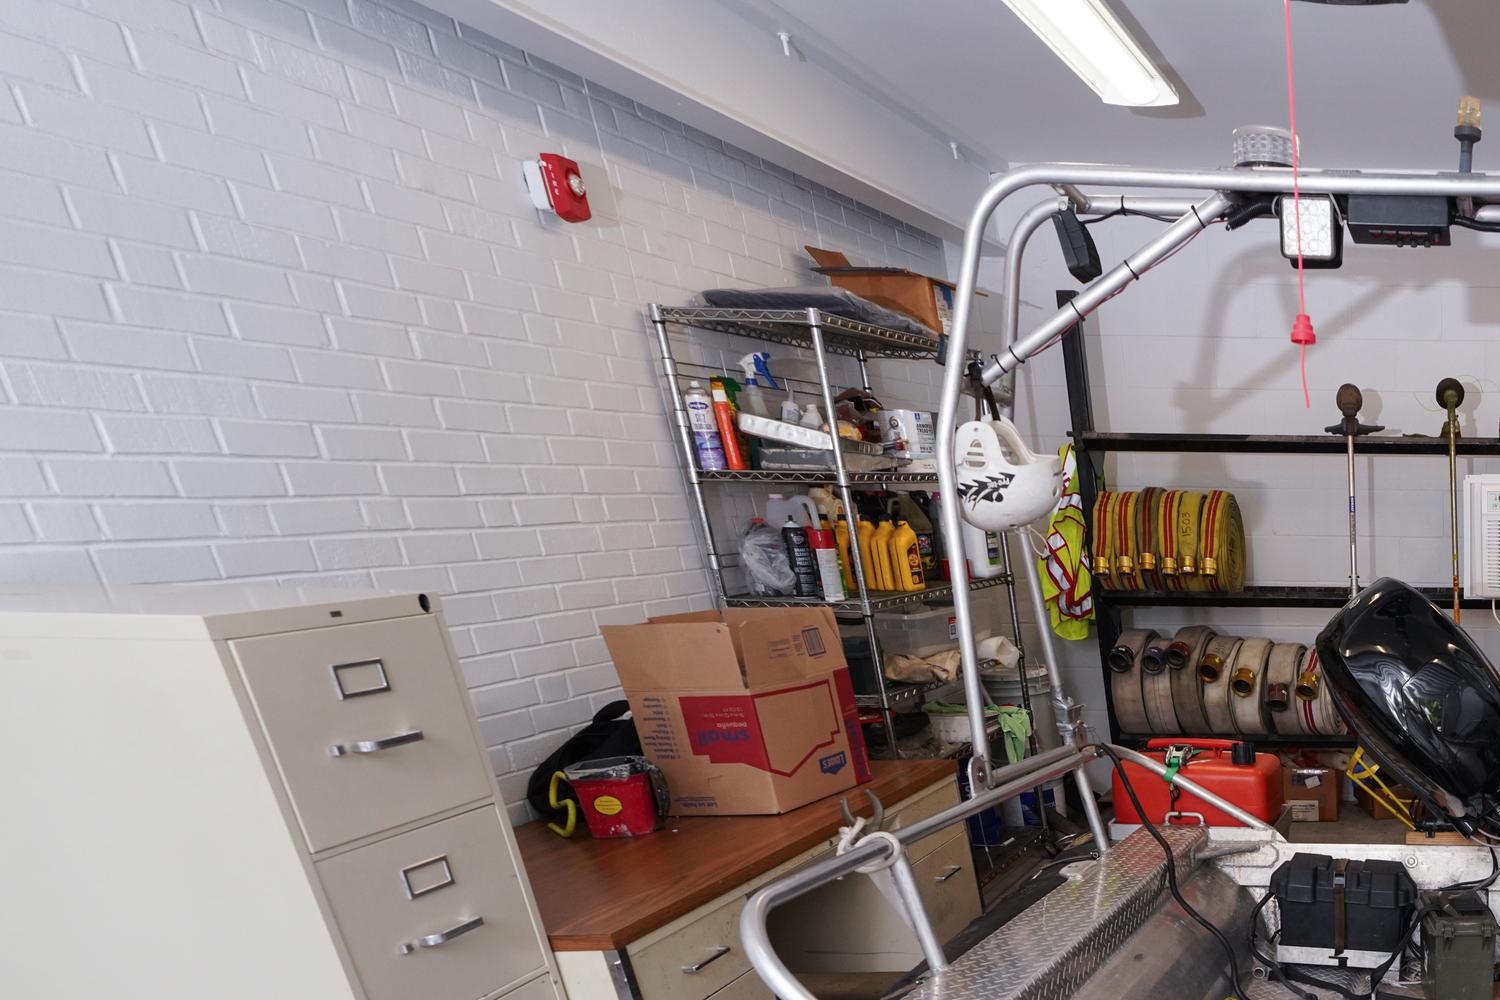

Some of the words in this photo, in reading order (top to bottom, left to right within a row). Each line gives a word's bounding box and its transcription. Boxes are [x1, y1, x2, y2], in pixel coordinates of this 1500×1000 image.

[548, 163, 560, 196] FIRE
[1181, 512, 1192, 537] 1503
[697, 730, 751, 747] small
